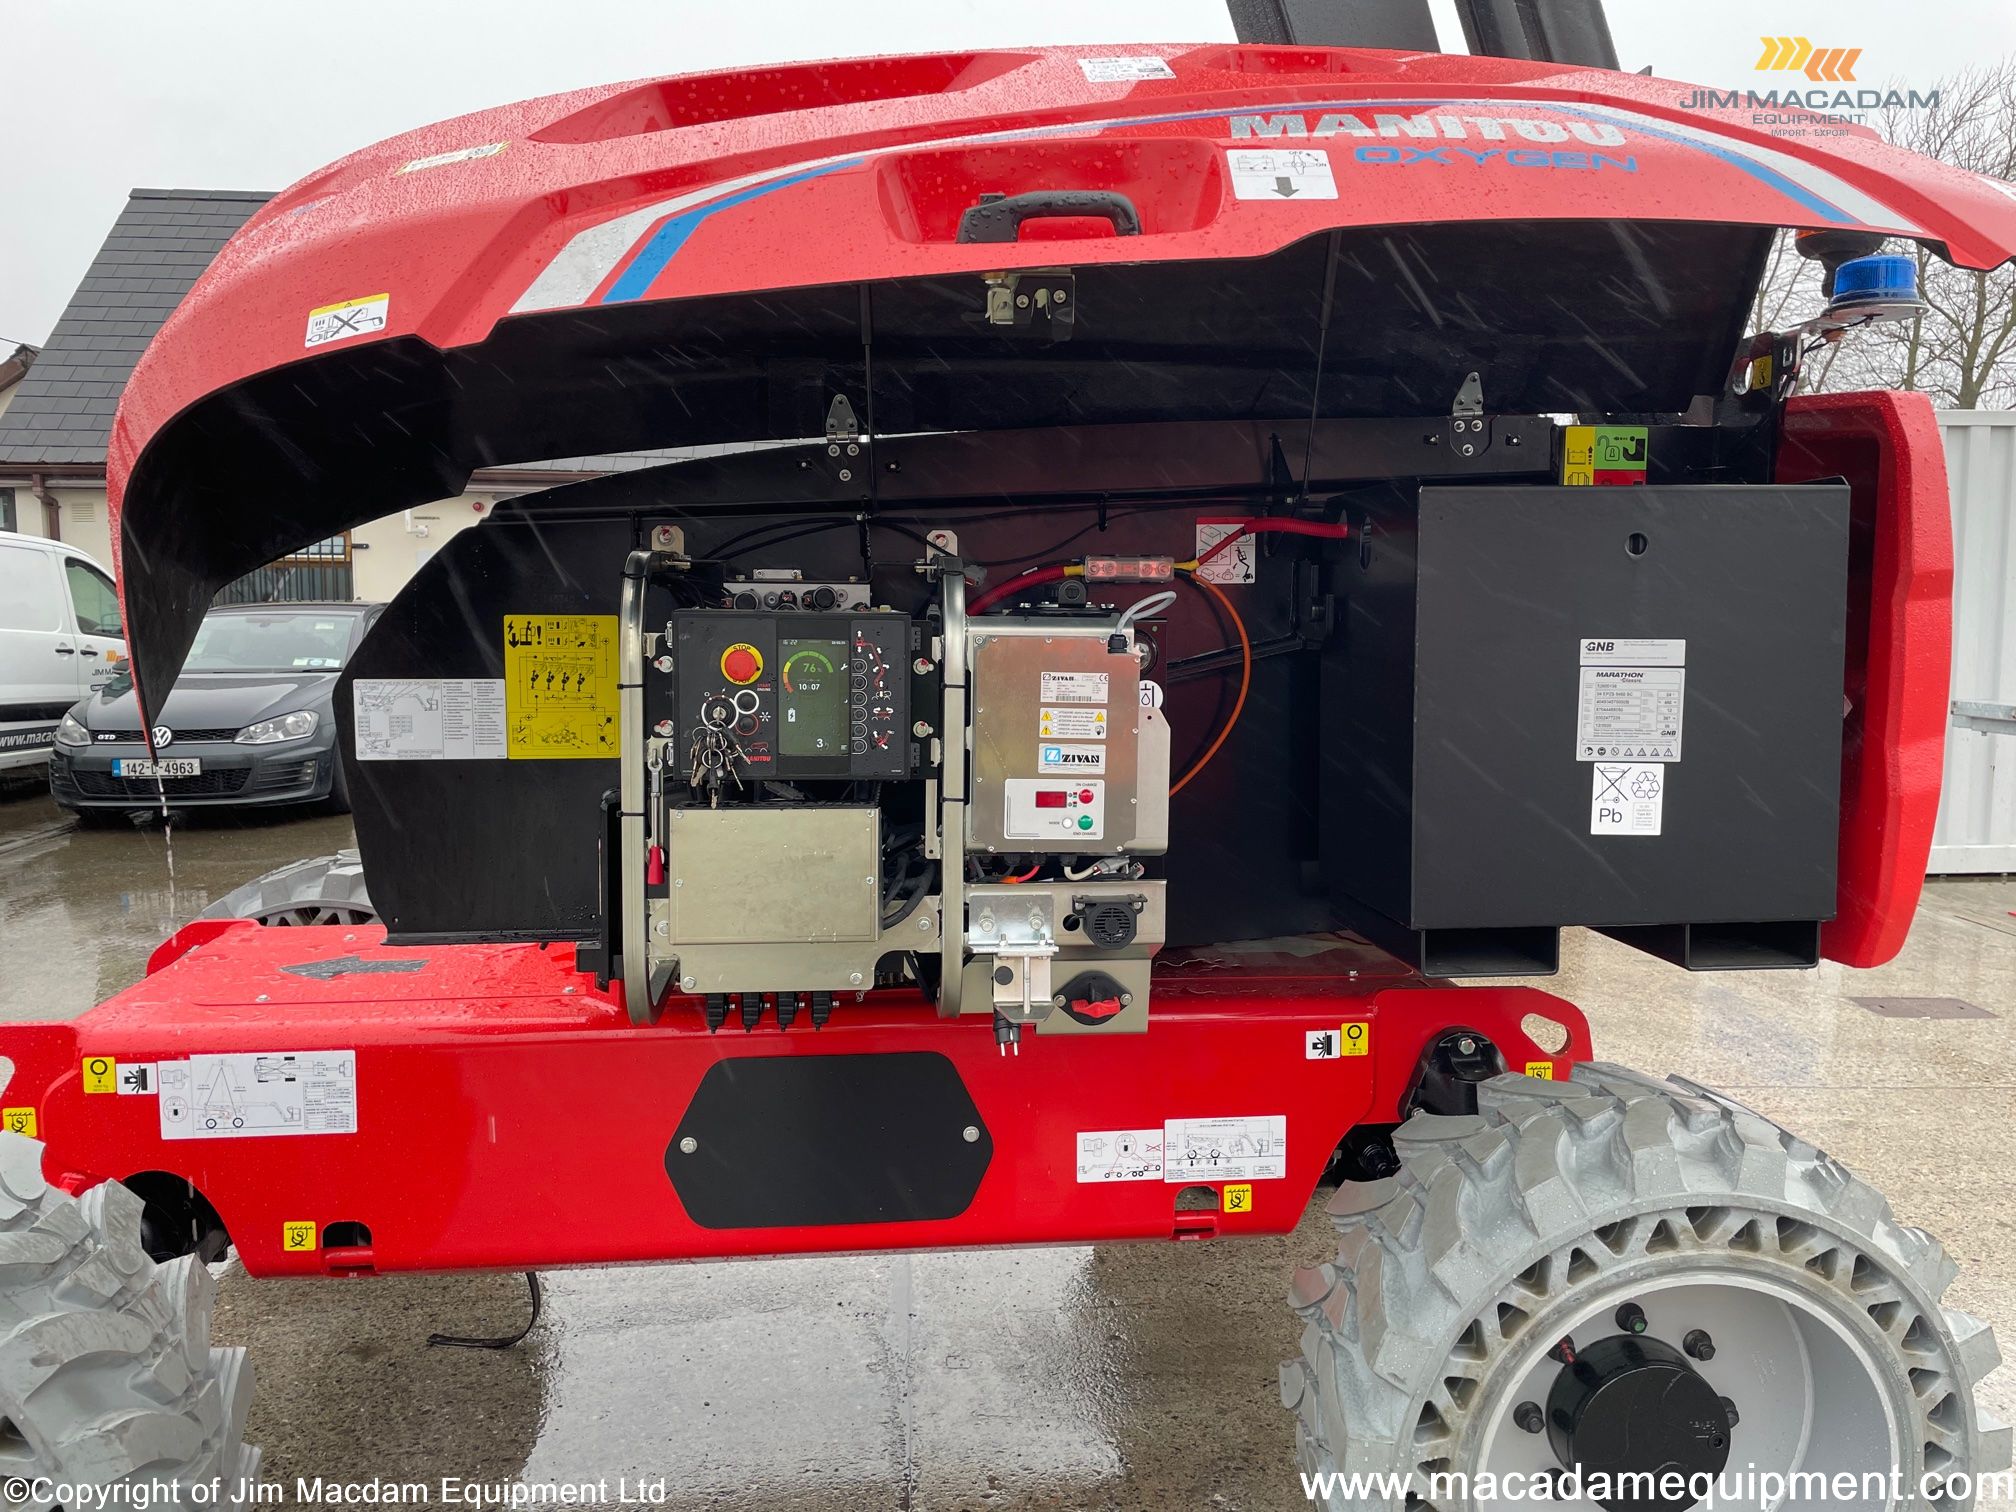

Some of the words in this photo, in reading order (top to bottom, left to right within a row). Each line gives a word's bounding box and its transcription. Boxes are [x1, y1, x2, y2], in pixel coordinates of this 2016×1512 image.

[1230, 113, 1627, 147] MANITOU
[1354, 146, 1638, 173] OXYGEN
[733, 644, 751, 652] STOP
[1585, 641, 1615, 652] GNB
[1061, 754, 1100, 763] ZIVAN
[1599, 808, 1623, 823] Pb
